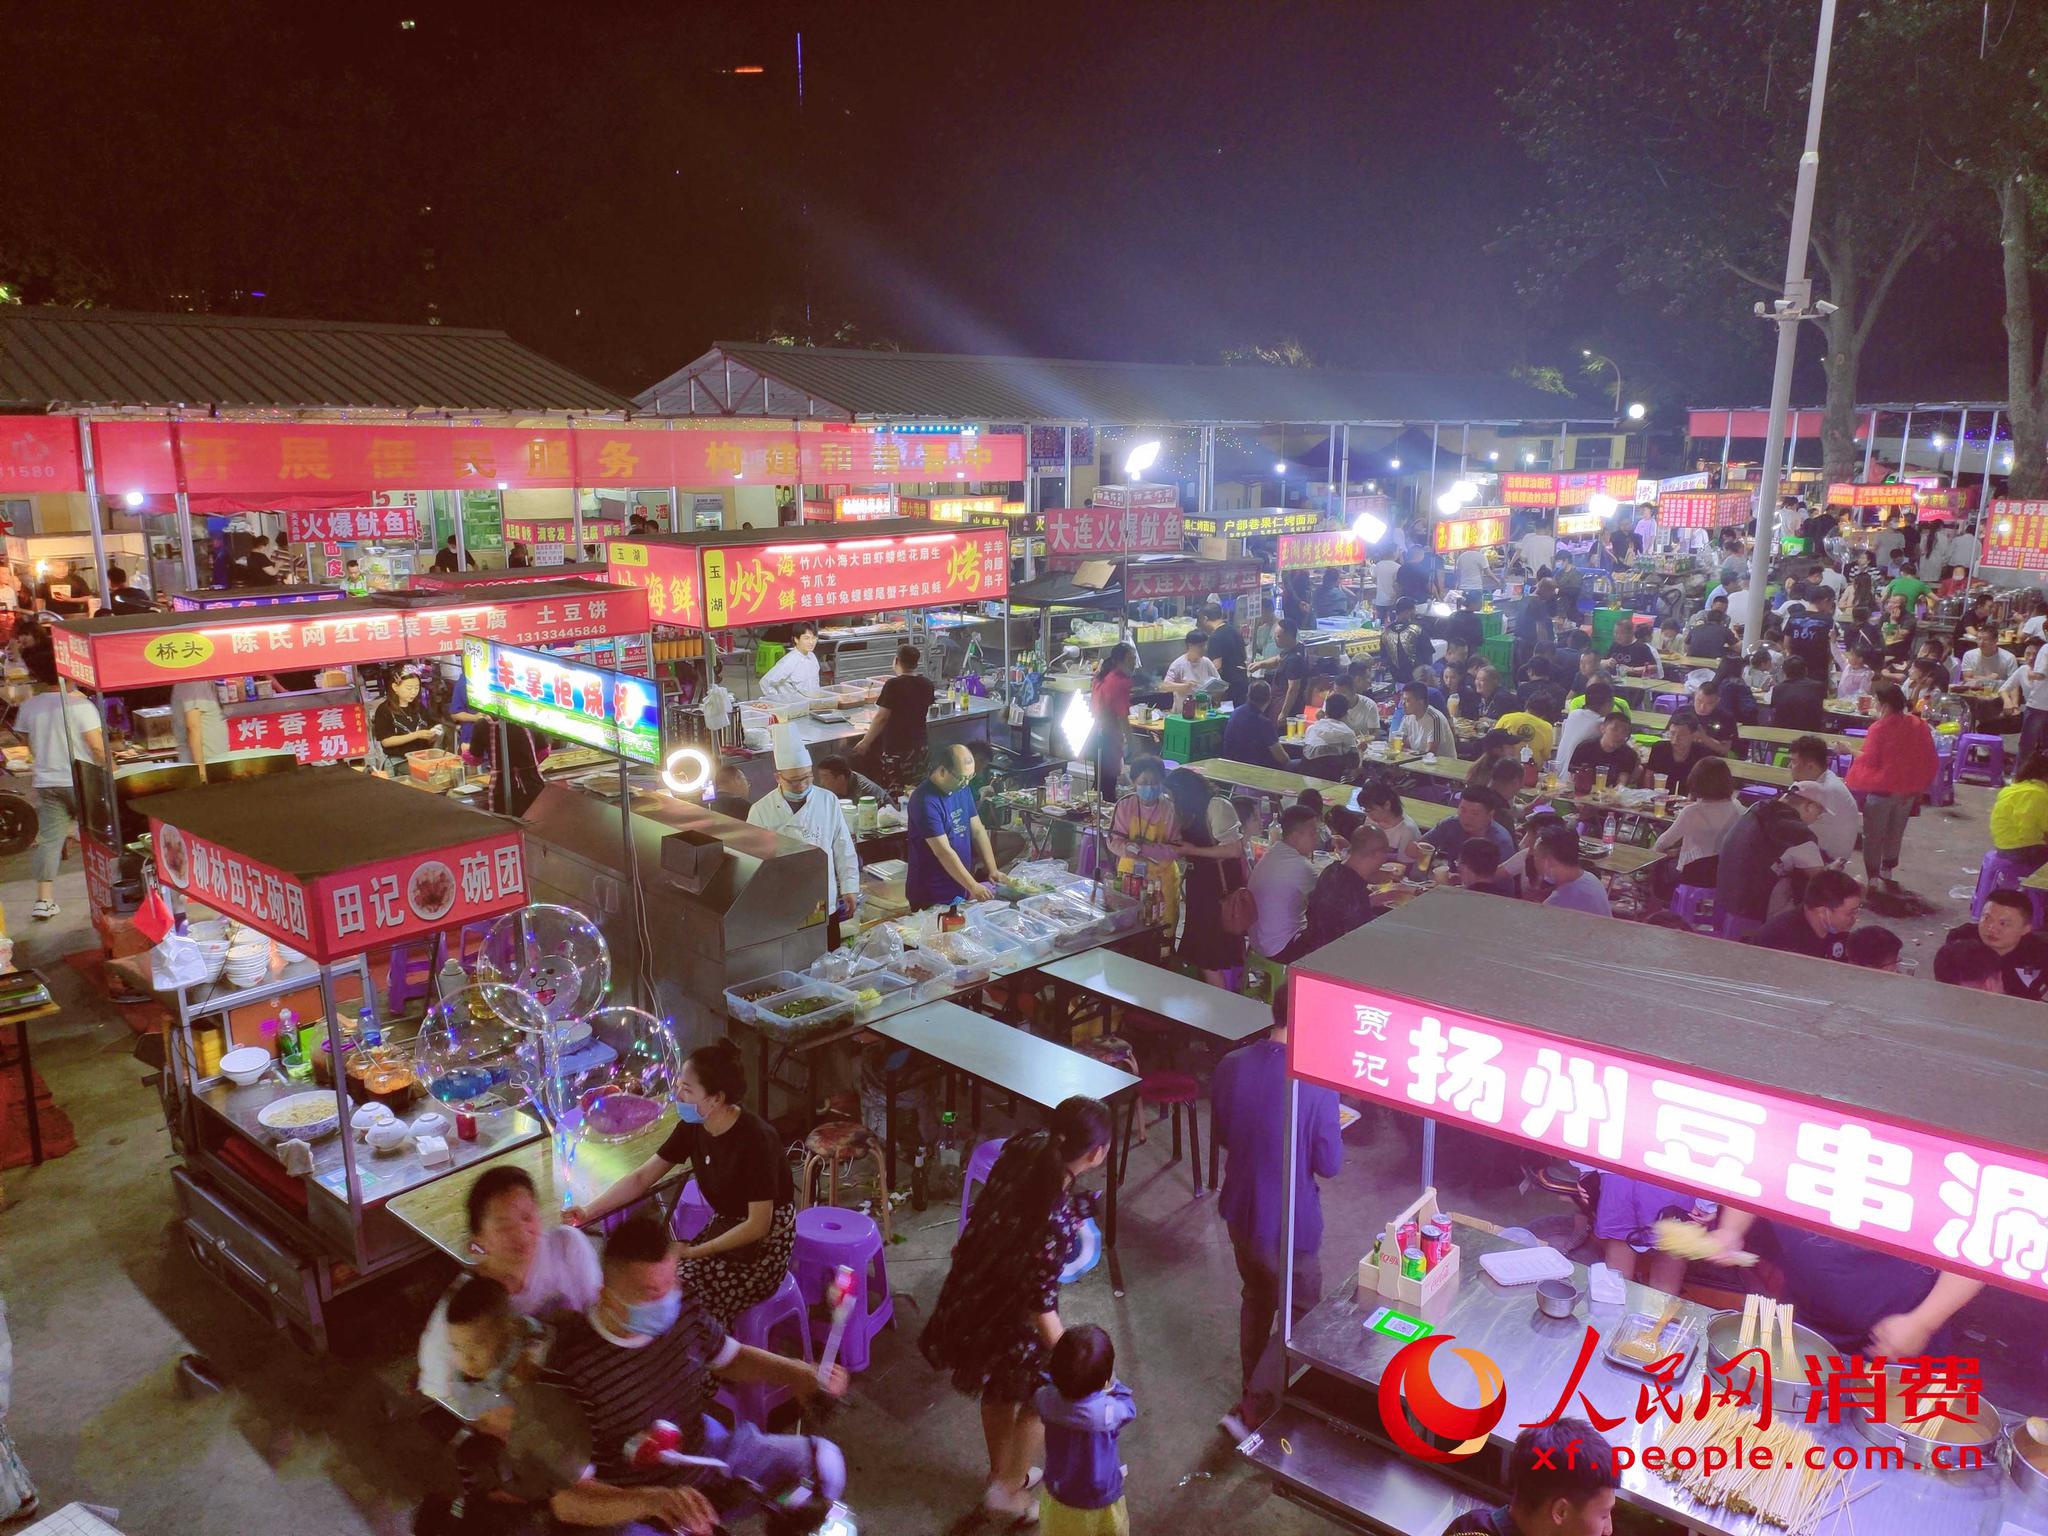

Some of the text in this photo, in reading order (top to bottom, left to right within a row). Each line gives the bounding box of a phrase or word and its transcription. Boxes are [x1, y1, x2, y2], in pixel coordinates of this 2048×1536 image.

[302, 512, 406, 540] 火爆鱿鱼
[1050, 513, 1181, 550] 大连火爆鱿鱼
[777, 554, 797, 612] 海鲜
[946, 541, 982, 593] 烤
[709, 565, 723, 612] 玉湖
[537, 600, 608, 625] 土豆饼
[156, 640, 203, 661] 桥头
[516, 624, 606, 643] 13133445848
[1793, 629, 1816, 640] BOY
[237, 708, 346, 741] 炸香蕉
[191, 839, 309, 941] 柳林田记碗团
[333, 844, 524, 939] 田记 碗团
[1351, 1004, 1393, 1087] 贾记
